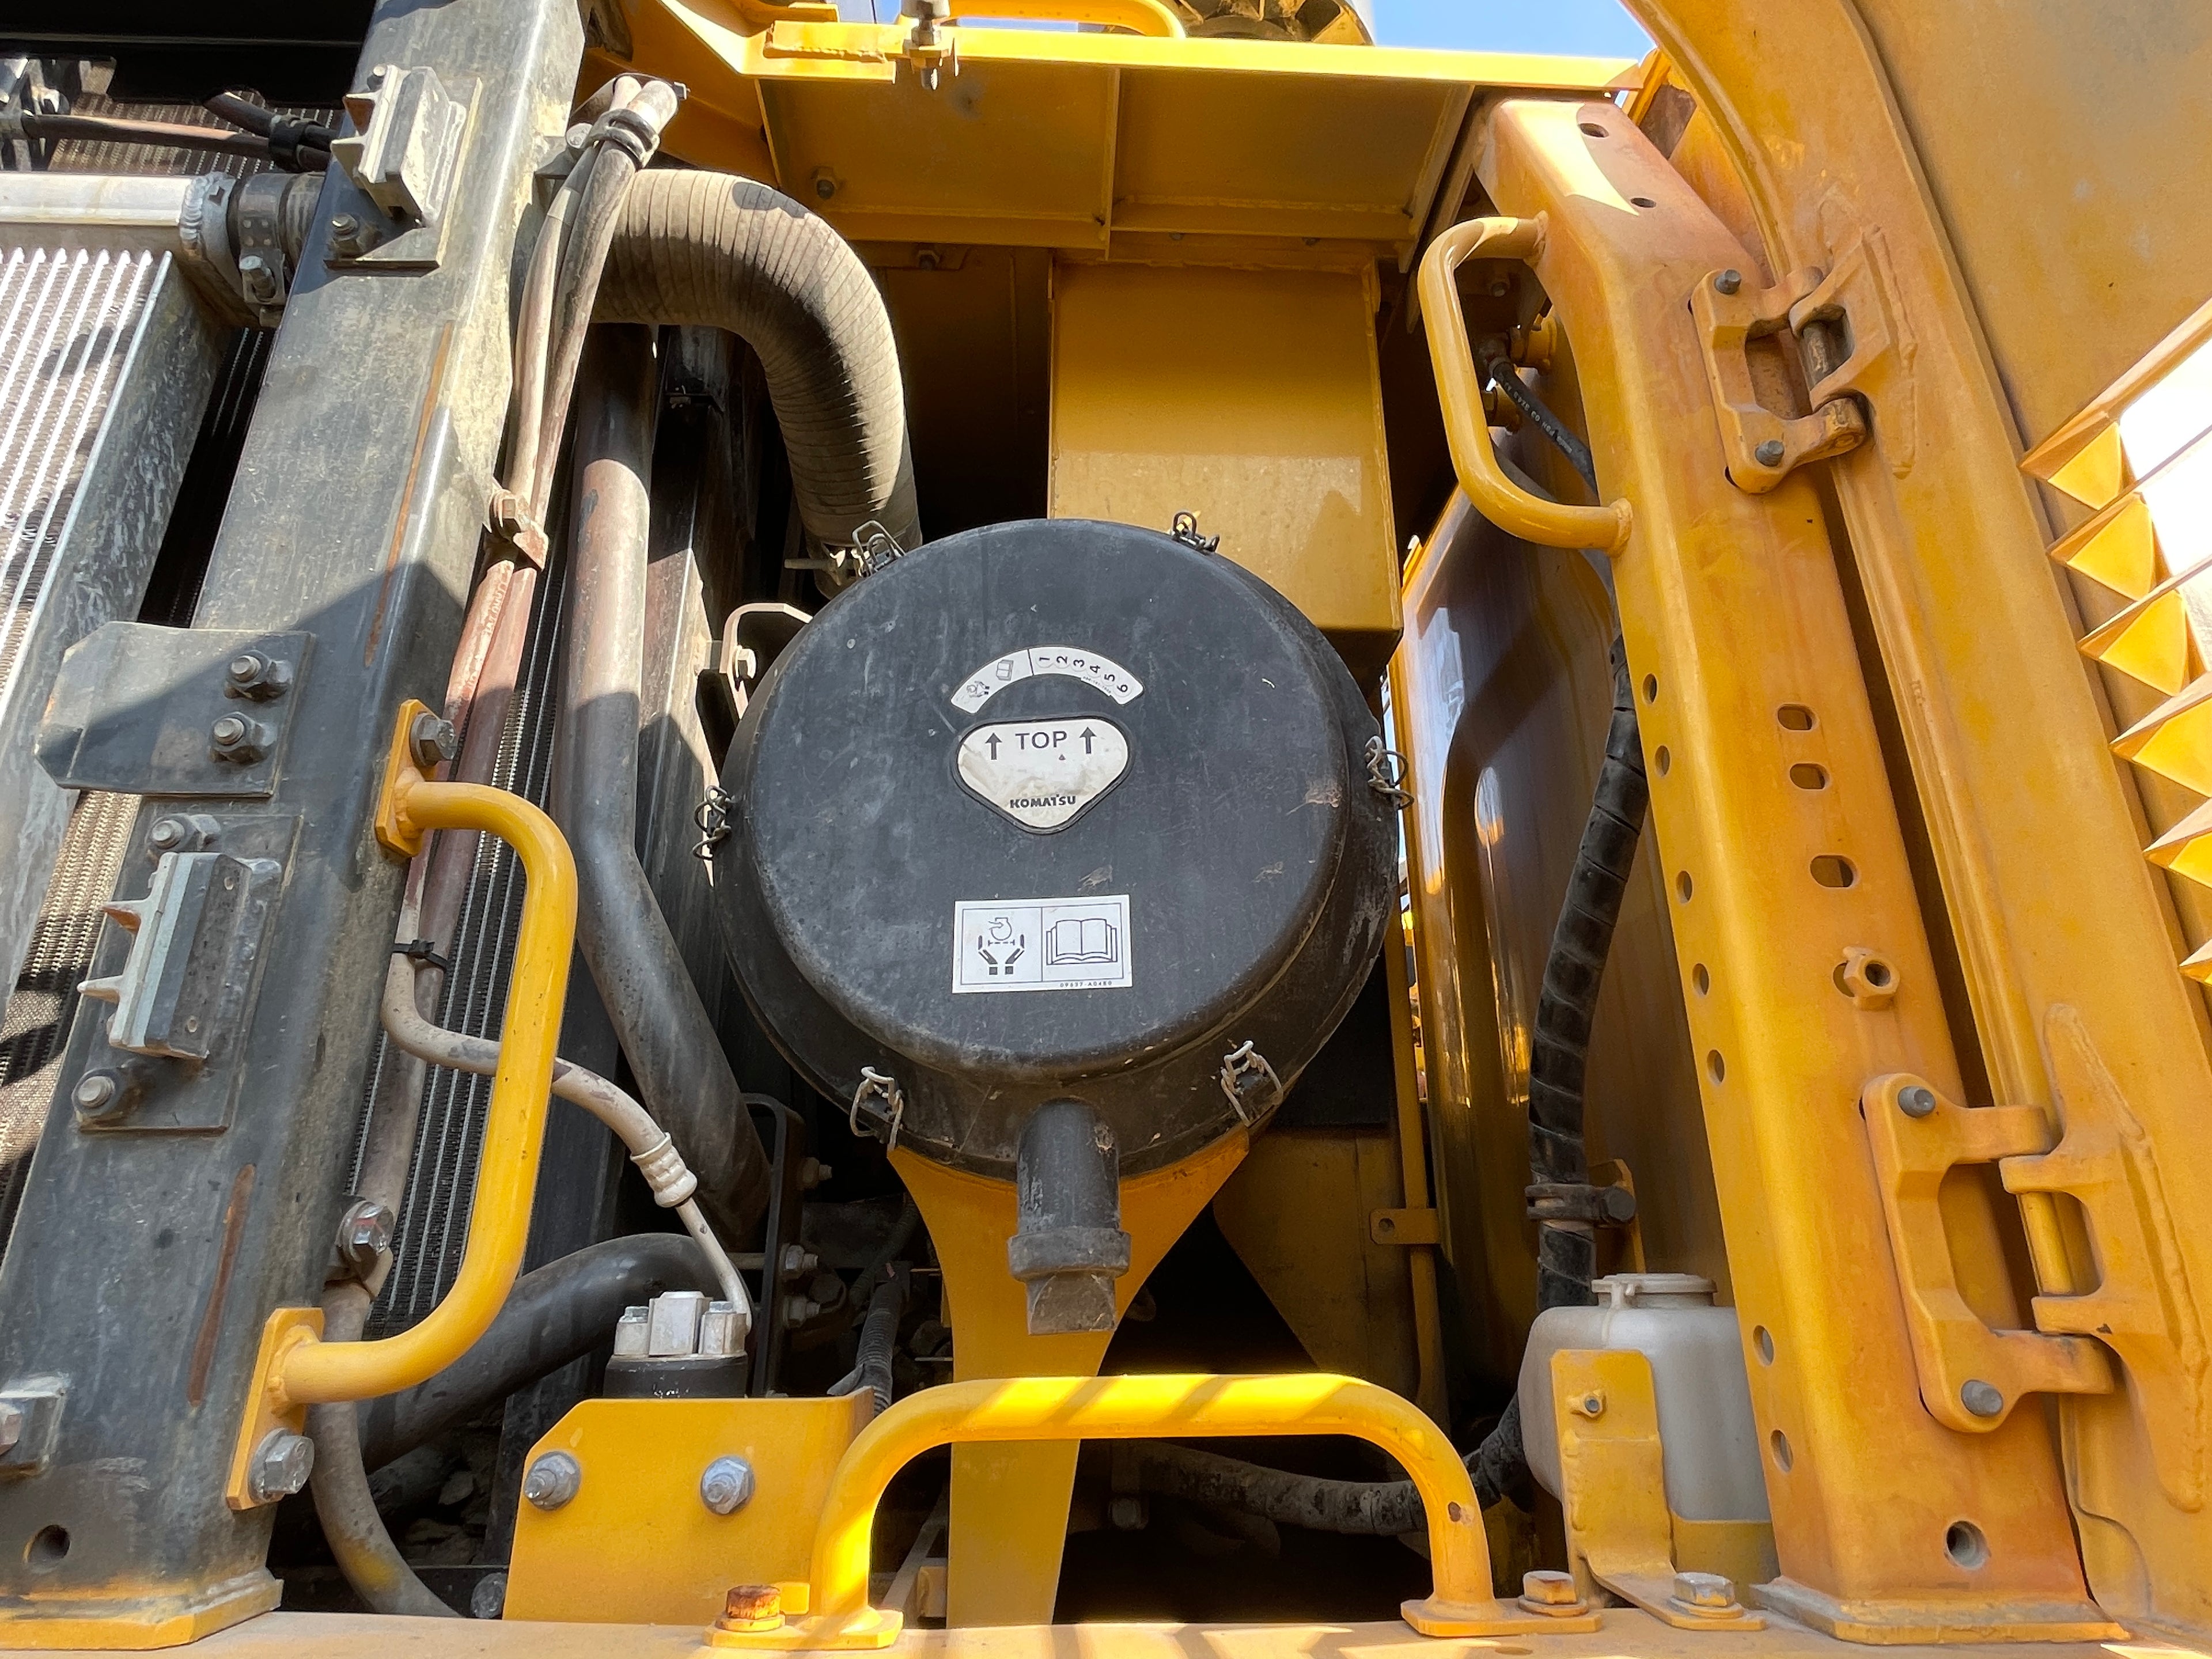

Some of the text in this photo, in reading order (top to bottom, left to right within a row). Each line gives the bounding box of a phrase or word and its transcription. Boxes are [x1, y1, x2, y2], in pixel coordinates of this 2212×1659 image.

[1056, 656, 1068, 664] 2
[1073, 659, 1085, 667] 3
[1090, 665, 1101, 673] 4
[1104, 673, 1116, 682] 5
[1116, 684, 1128, 692] 6
[1015, 731, 1068, 751] TOP
[1010, 793, 1076, 809] KOMATSU
